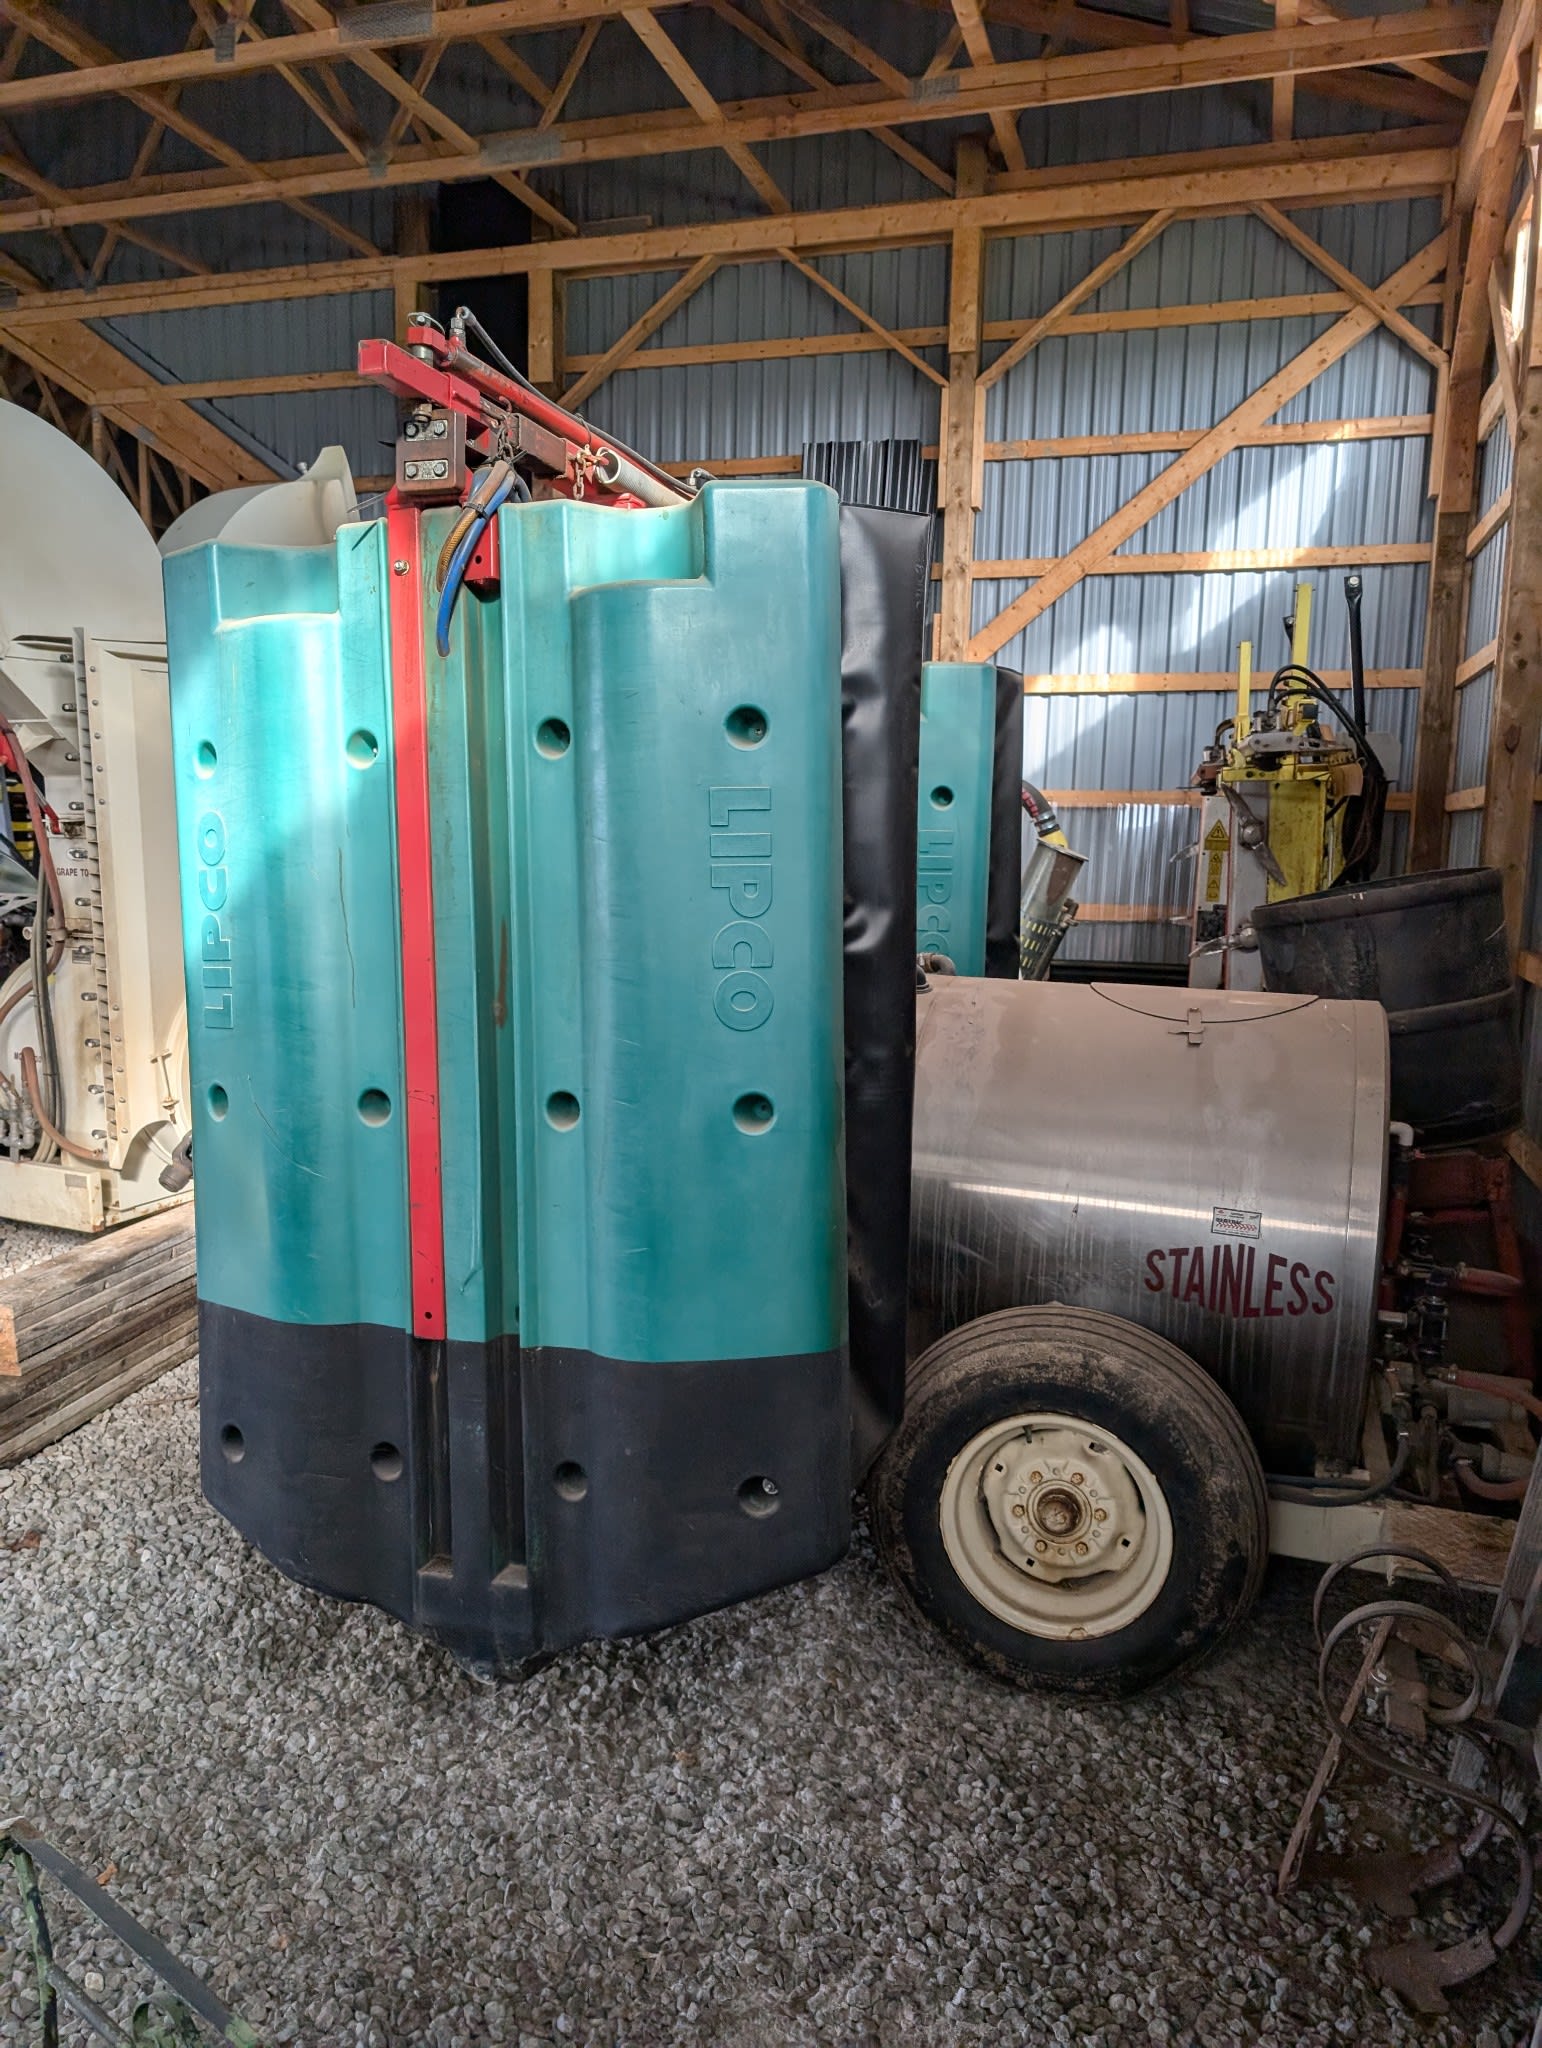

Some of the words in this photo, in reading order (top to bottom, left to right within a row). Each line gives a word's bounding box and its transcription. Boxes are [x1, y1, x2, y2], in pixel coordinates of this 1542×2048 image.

[56, 867, 78, 877] GRAPE
[198, 810, 234, 1030] LIPCO
[709, 786, 775, 1032] LIPCO
[1144, 1243, 1336, 1318] STAINLESS
